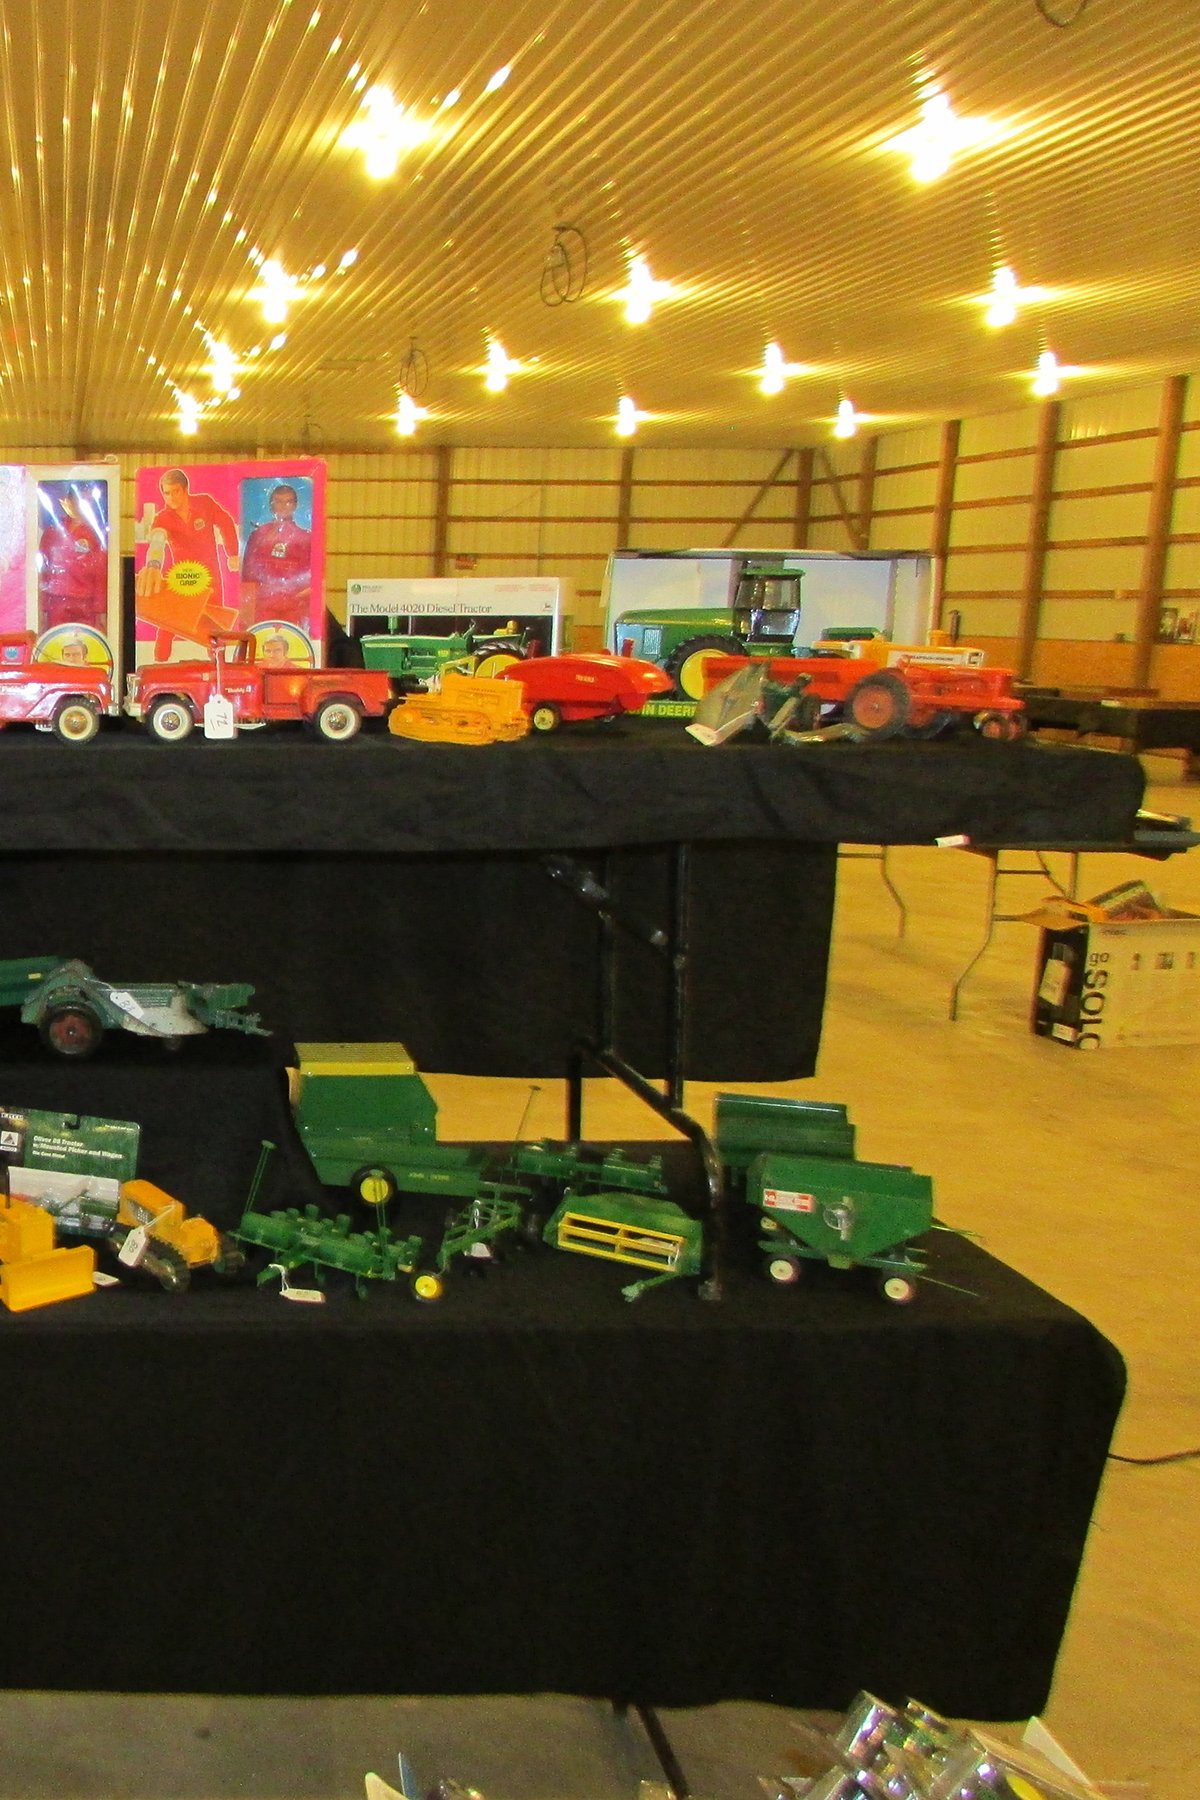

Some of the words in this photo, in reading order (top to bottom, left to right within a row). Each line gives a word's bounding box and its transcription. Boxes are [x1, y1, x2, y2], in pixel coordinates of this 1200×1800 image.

[350, 602, 368, 614] The
[370, 602, 399, 614] Model
[400, 603, 425, 614] 4020
[426, 602, 456, 614] Diesel
[458, 602, 493, 614] Tractor
[61, 1139, 84, 1147] Tractor
